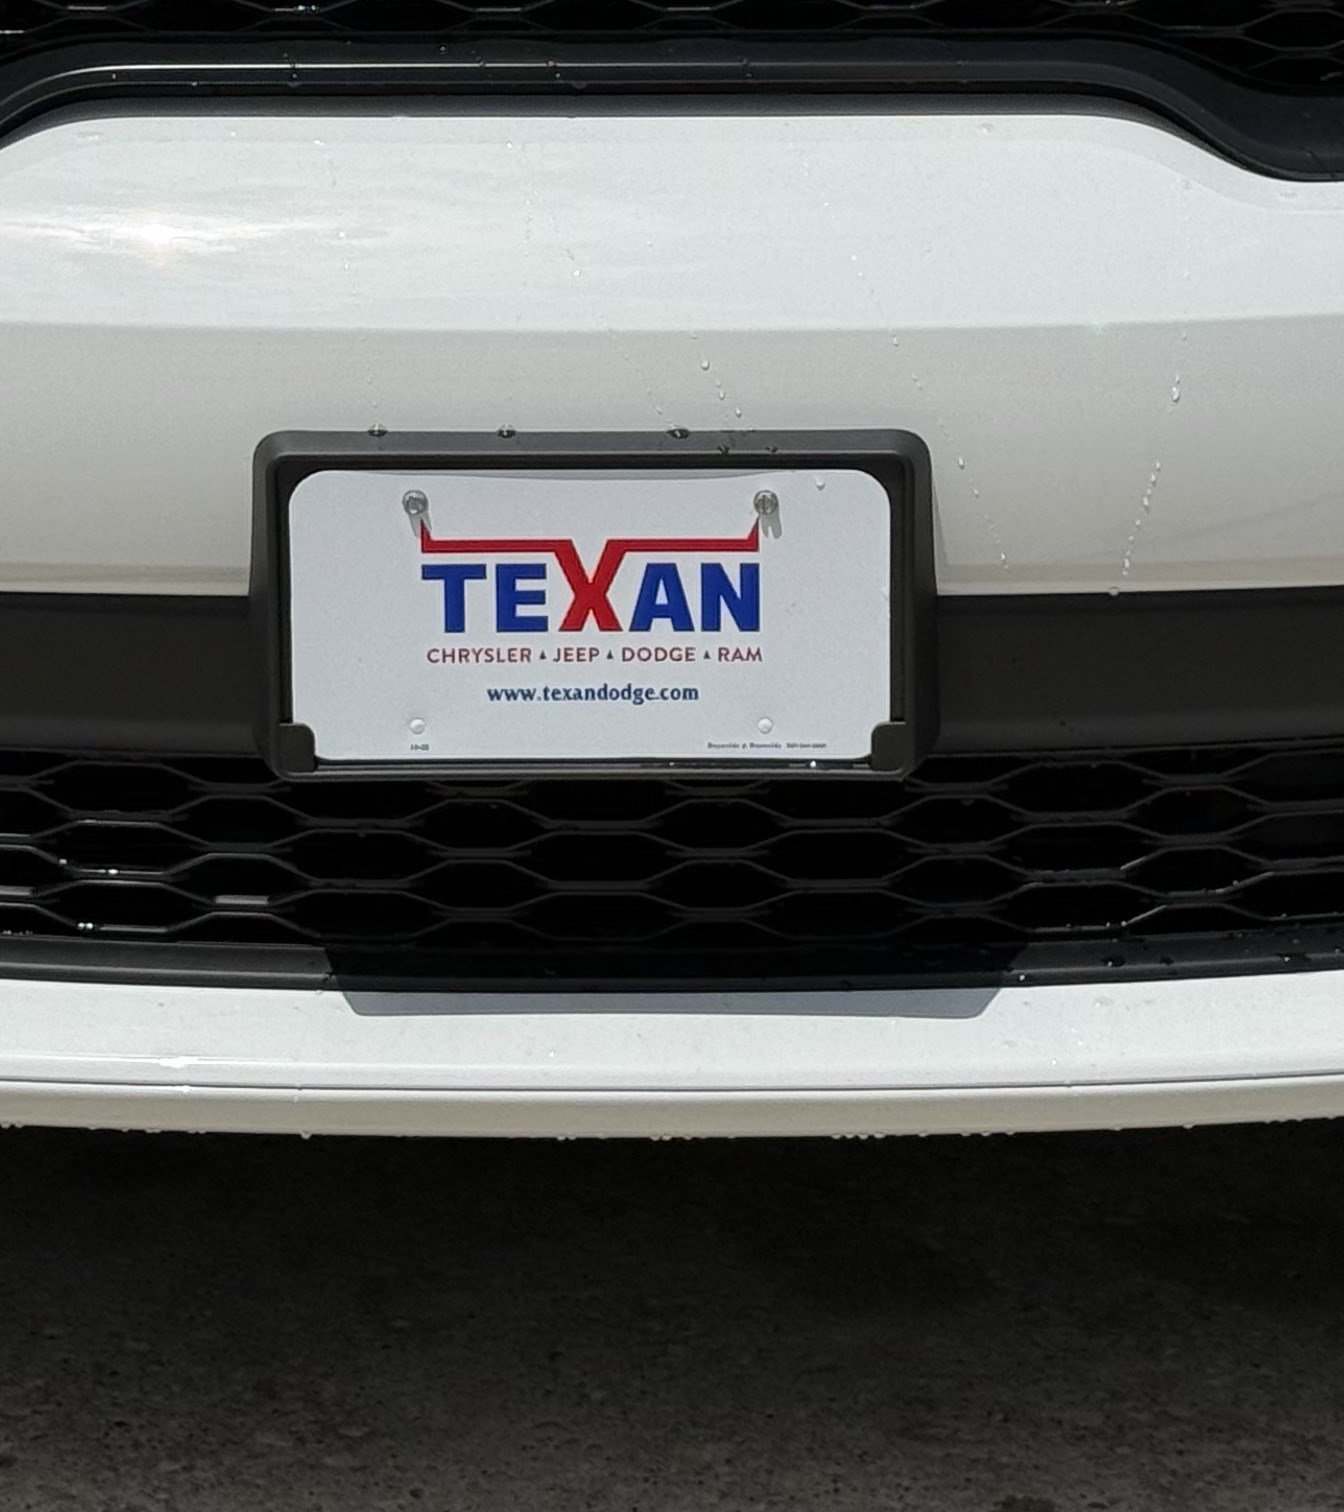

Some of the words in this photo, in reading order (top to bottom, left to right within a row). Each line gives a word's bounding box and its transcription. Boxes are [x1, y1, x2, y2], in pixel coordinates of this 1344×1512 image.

[421, 540, 761, 633] TEXAN
[427, 647, 532, 664] CHRYSLER
[553, 646, 600, 663] JEEP
[621, 646, 696, 662] DODGE
[717, 646, 763, 662] RAM
[487, 683, 700, 705] www.texandodge.com
